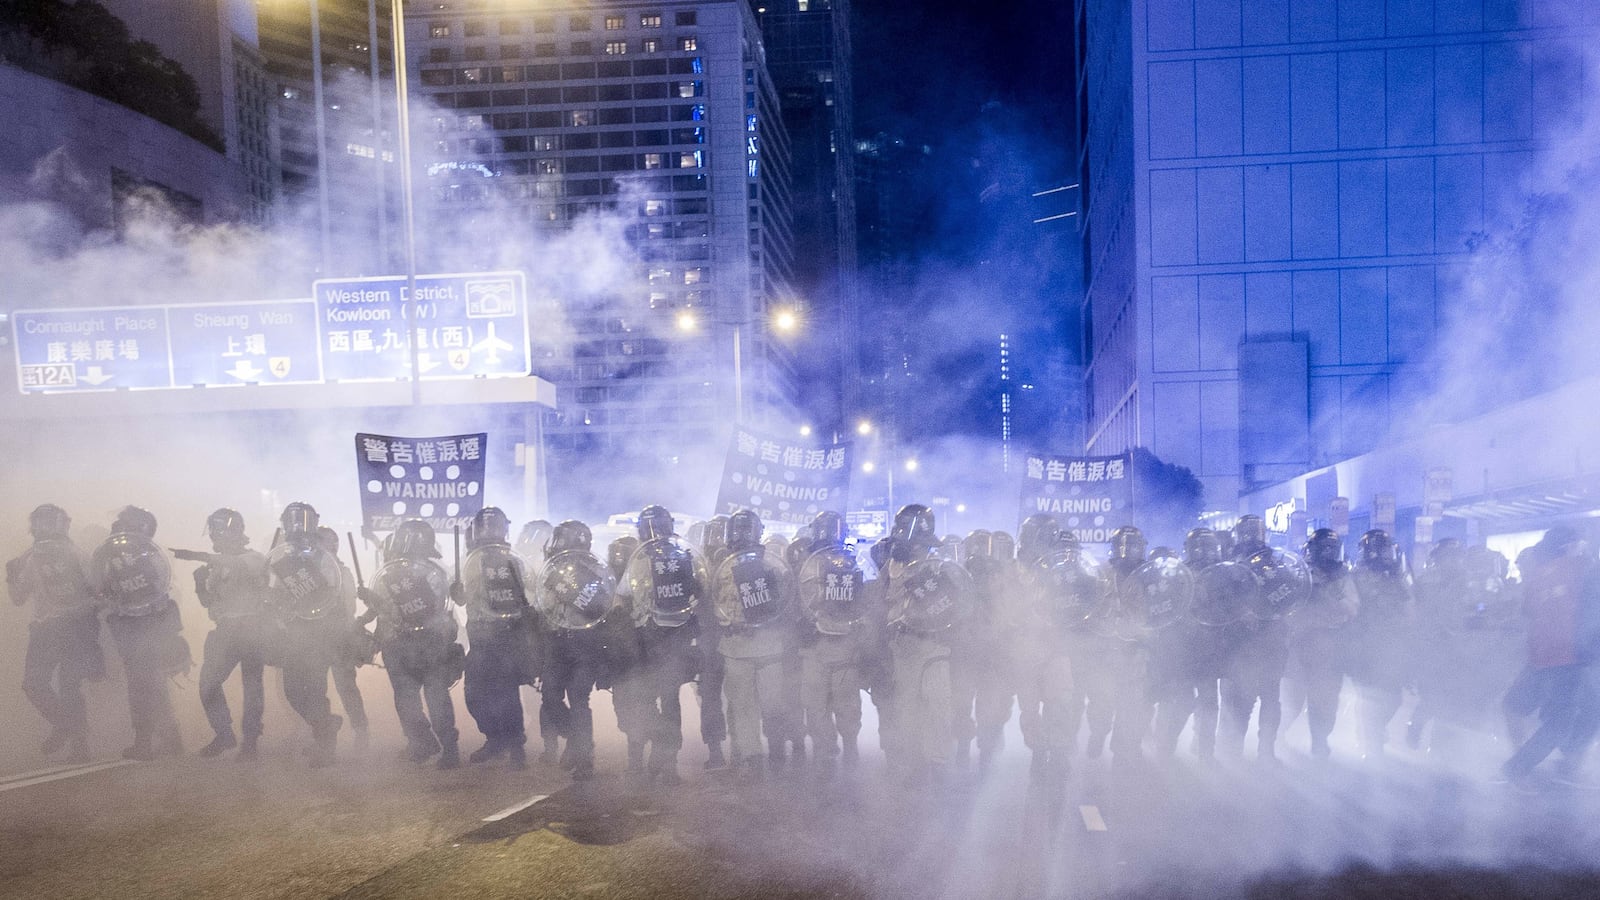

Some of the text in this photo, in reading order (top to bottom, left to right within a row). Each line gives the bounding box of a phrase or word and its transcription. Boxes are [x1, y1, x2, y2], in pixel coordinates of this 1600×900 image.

[326, 285, 458, 304] Western Dstrict,
[193, 311, 293, 330] Sheung Wan
[326, 306, 390, 322] Kowloon
[24, 315, 157, 335] Connaught Place
[275, 360, 286, 372] 4
[454, 354, 465, 366] 4
[35, 366, 73, 385] 12A
[363, 437, 480, 464] 警告催淚煙
[1027, 457, 1124, 482] 警告催淚煙
[385, 481, 467, 498] WARNING
[747, 474, 828, 501] WARNING
[1036, 496, 1112, 513] WARNING
[657, 583, 684, 599] POLICE
[742, 589, 772, 609] POLICE
[825, 587, 854, 601] POLICE
